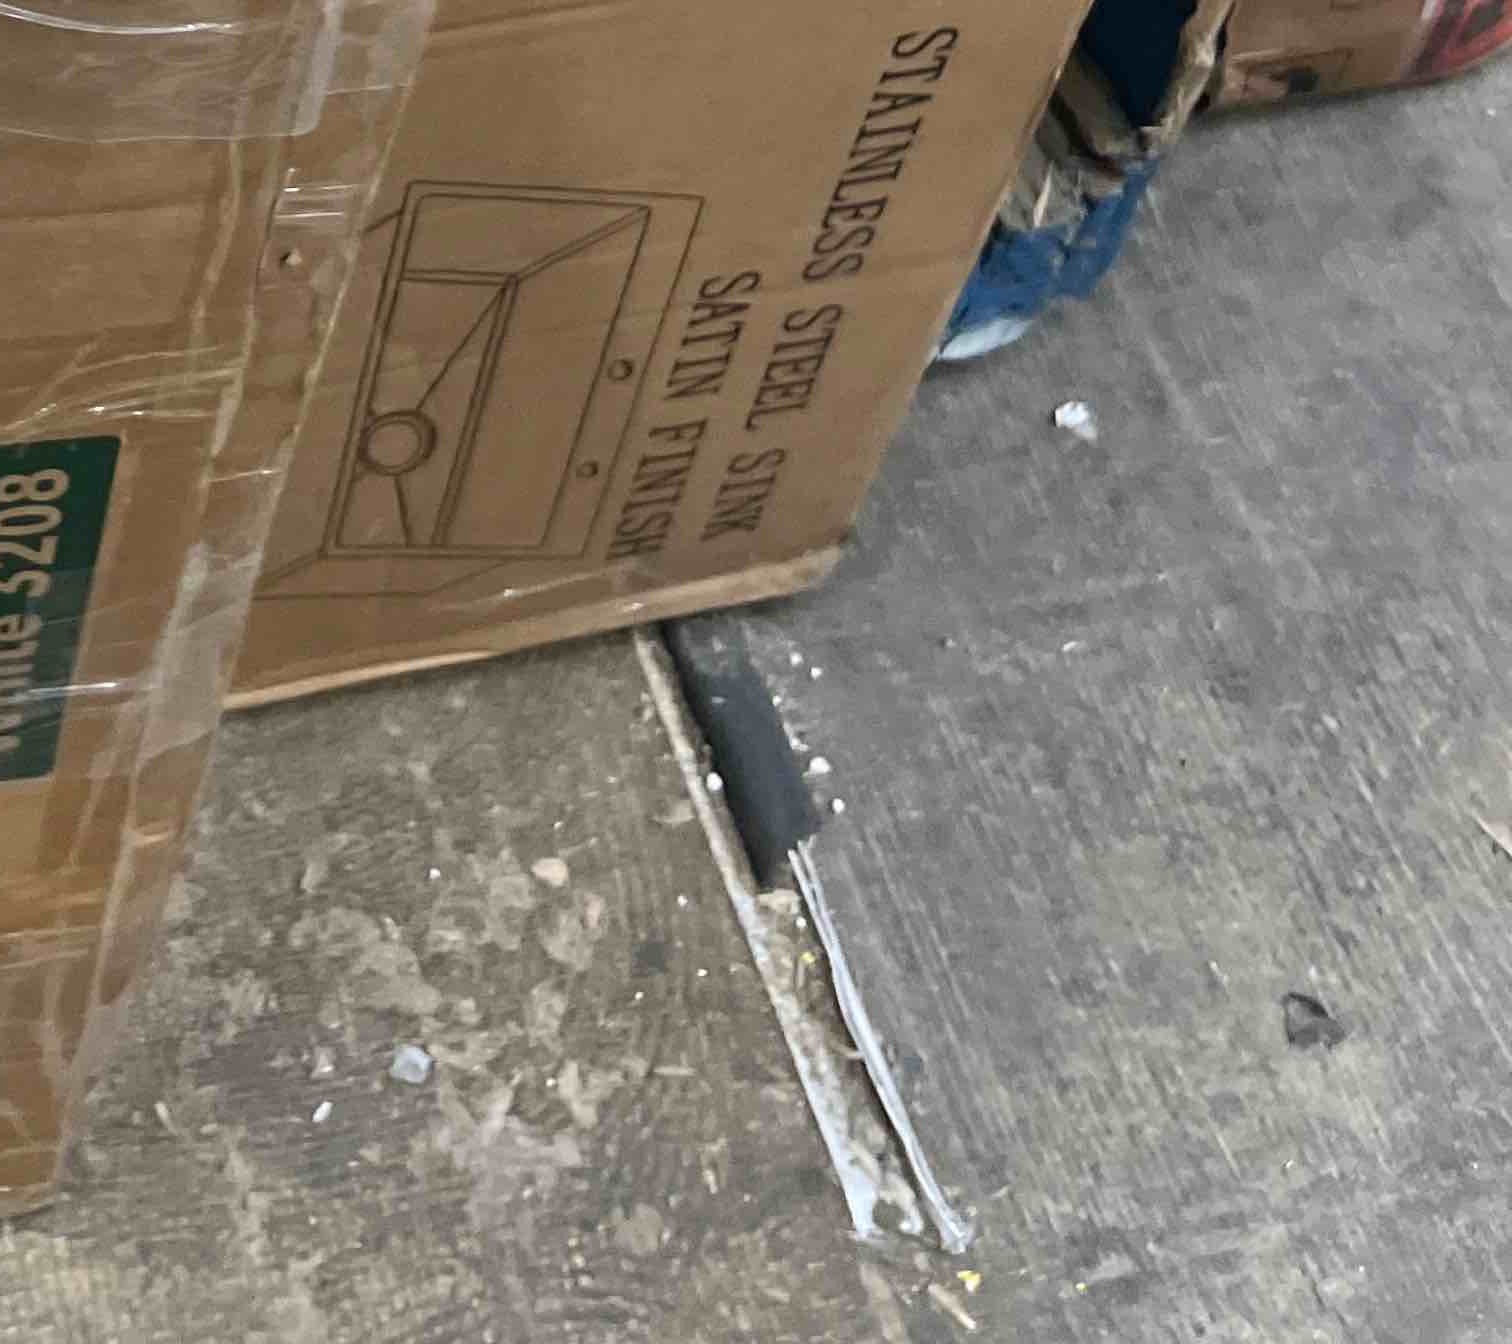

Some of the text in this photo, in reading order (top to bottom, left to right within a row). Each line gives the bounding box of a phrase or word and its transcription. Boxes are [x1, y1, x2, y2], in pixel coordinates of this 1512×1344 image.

[605, 269, 762, 562] SATIN FINISH
[700, 25, 960, 542] STAINLESS STEEL SINK
